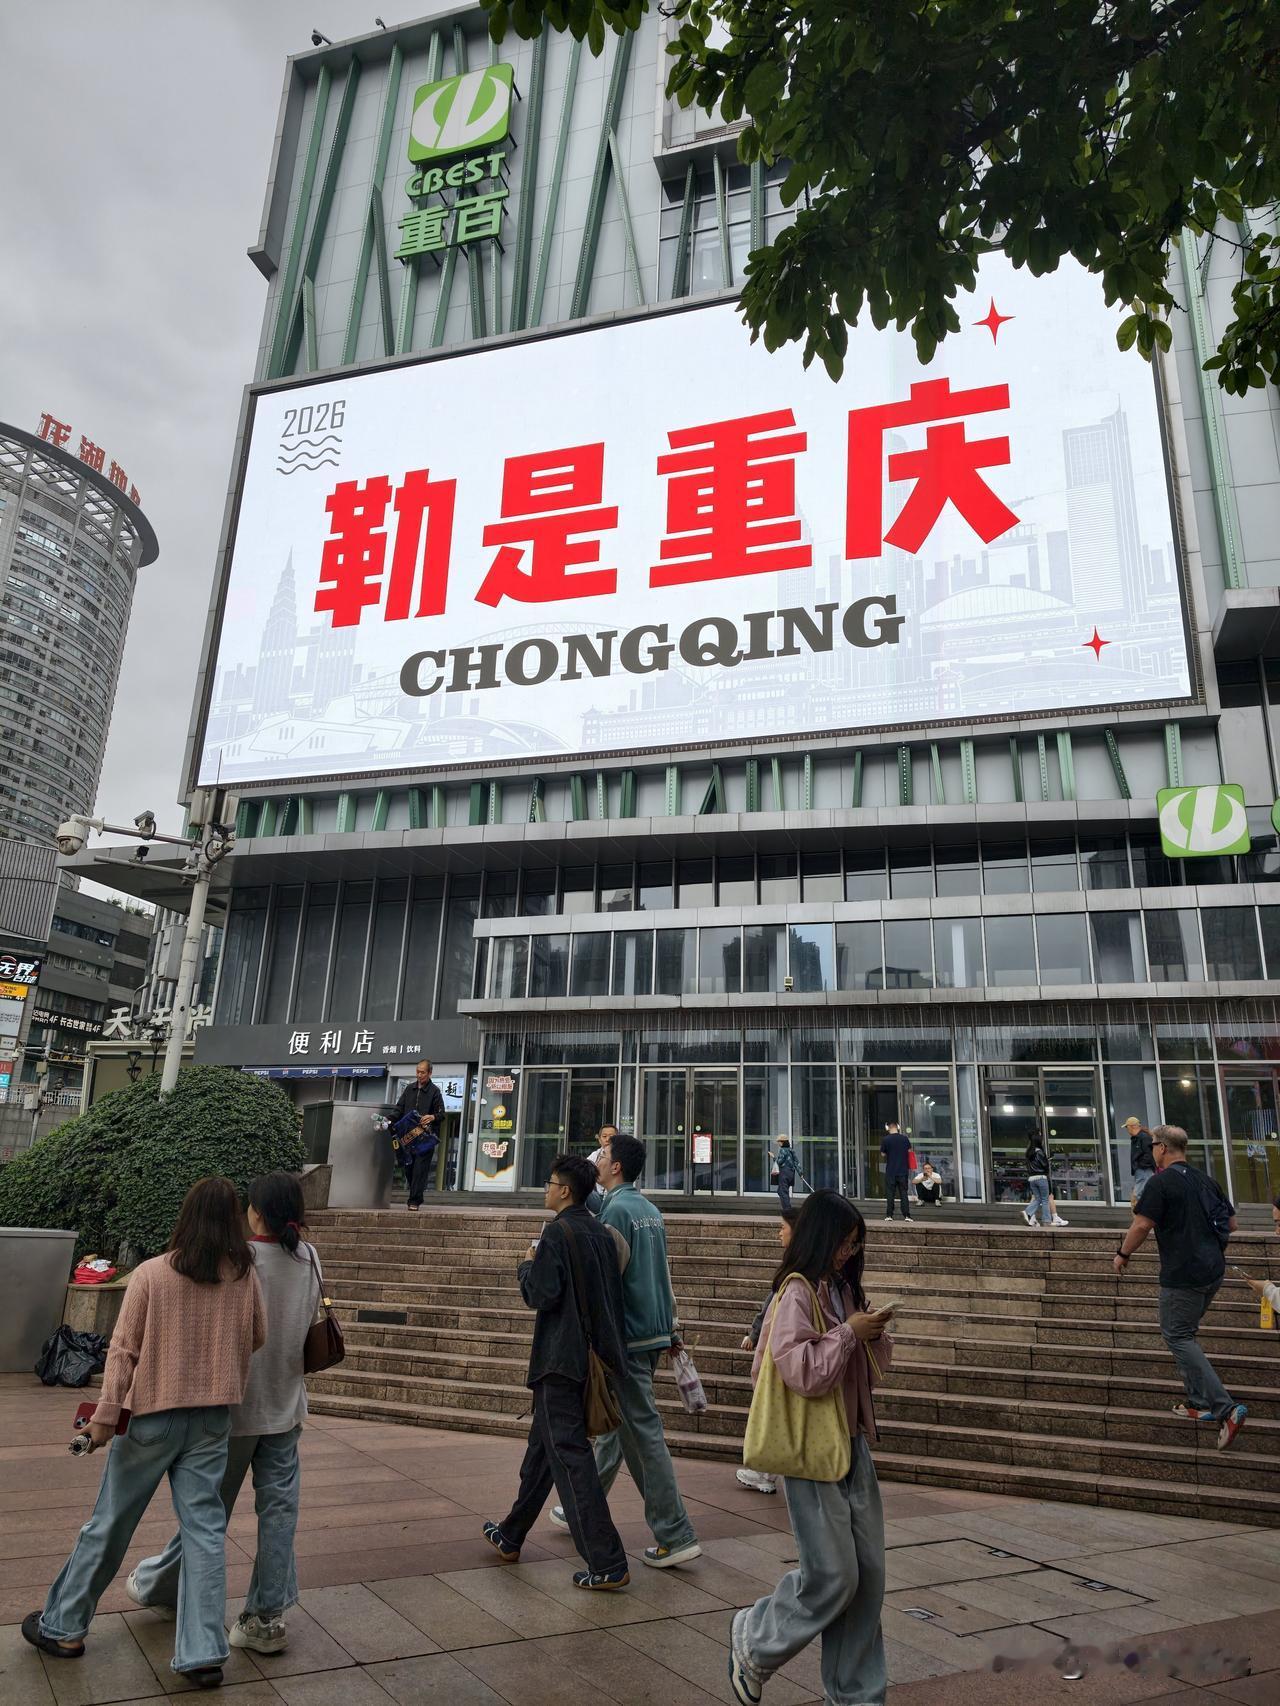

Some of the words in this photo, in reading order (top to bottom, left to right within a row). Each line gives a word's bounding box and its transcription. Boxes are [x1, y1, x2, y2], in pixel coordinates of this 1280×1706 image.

[405, 152, 506, 196] CBEST
[394, 189, 510, 259] 重百
[282, 400, 346, 438] 2026
[314, 378, 1021, 628] 勒是重庆
[400, 595, 906, 697] CHONGQING
[0, 961, 35, 976] 无界
[288, 1029, 375, 1055] 便利店
[382, 1045, 397, 1054] 香烟
[406, 1045, 421, 1054] 饮料
